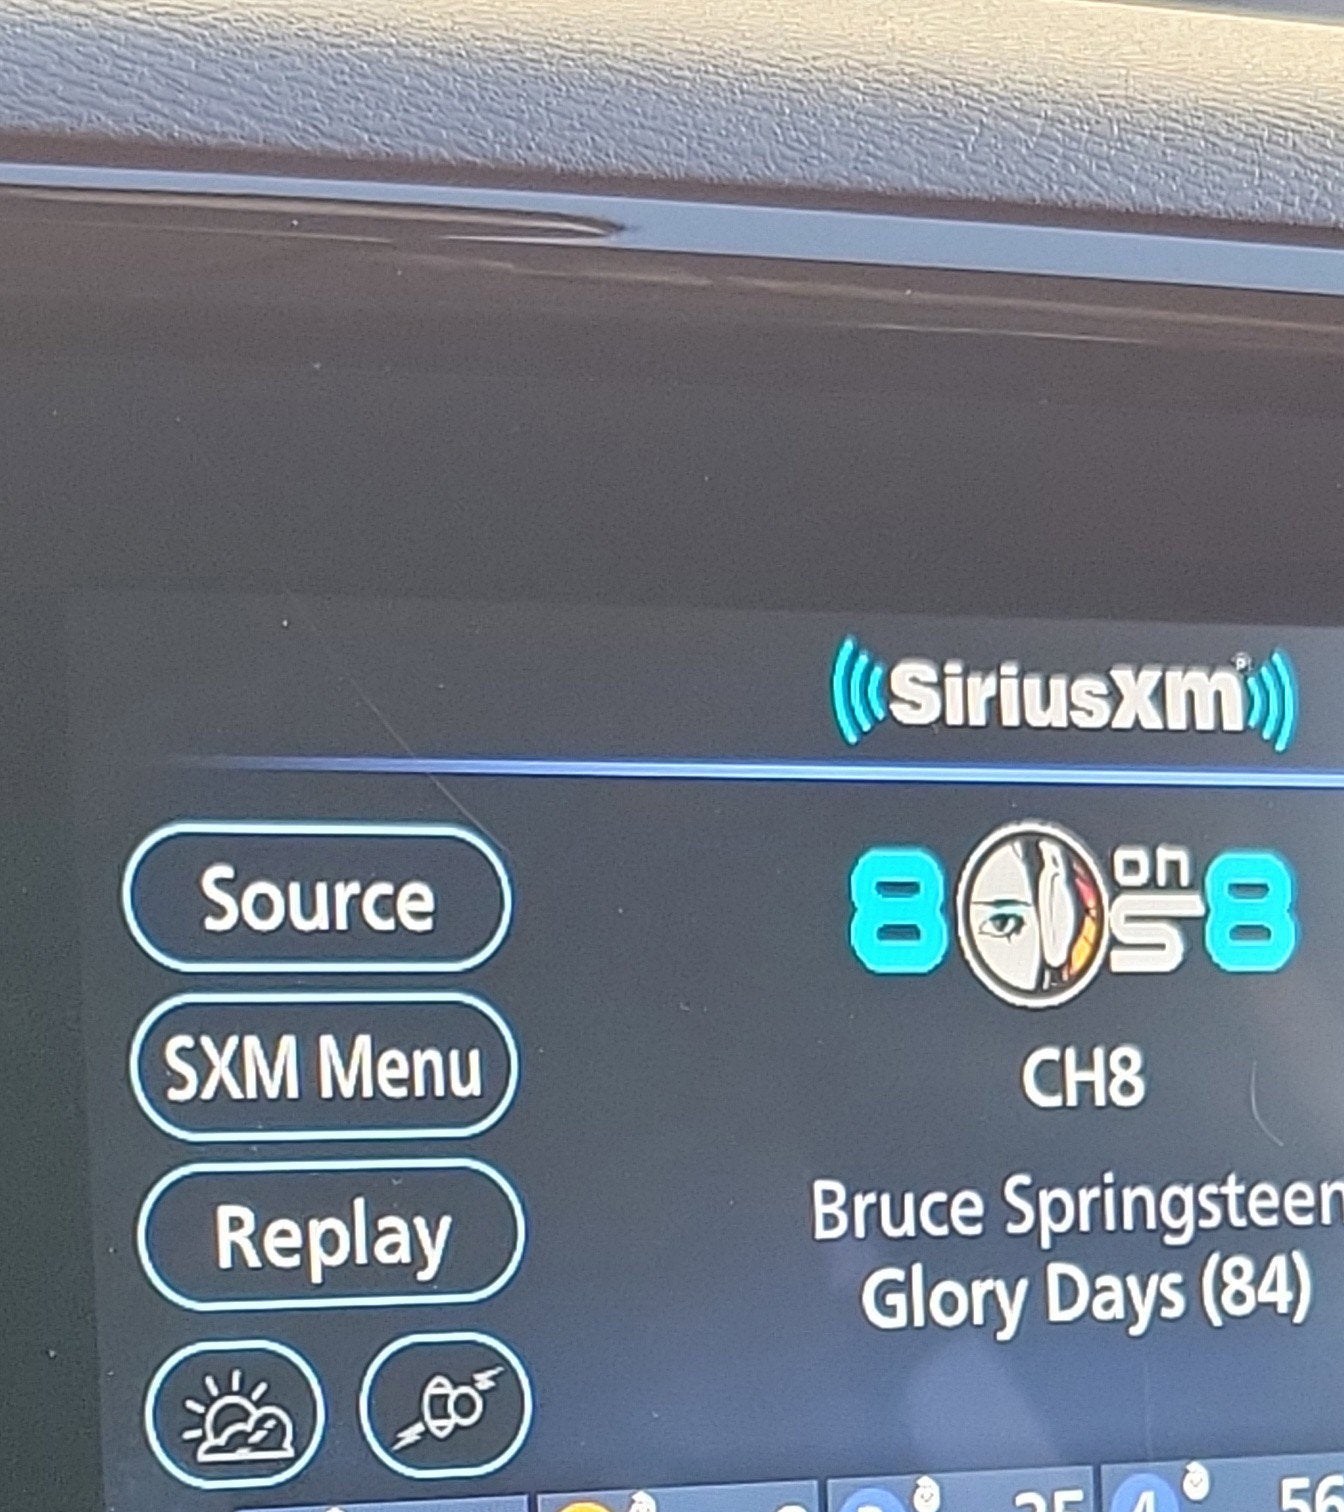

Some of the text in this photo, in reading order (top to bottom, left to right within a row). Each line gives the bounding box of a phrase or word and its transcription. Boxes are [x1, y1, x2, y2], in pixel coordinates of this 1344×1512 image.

[201, 862, 435, 933] Source
[1113, 845, 1189, 888] on
[1205, 851, 1297, 972] 8
[165, 1034, 482, 1101] SXM Menu
[1023, 1045, 1146, 1107] CH8
[216, 1197, 453, 1284] Replay
[812, 1179, 984, 1239] Bruce
[861, 1250, 1311, 1340] Glory Days (84)
